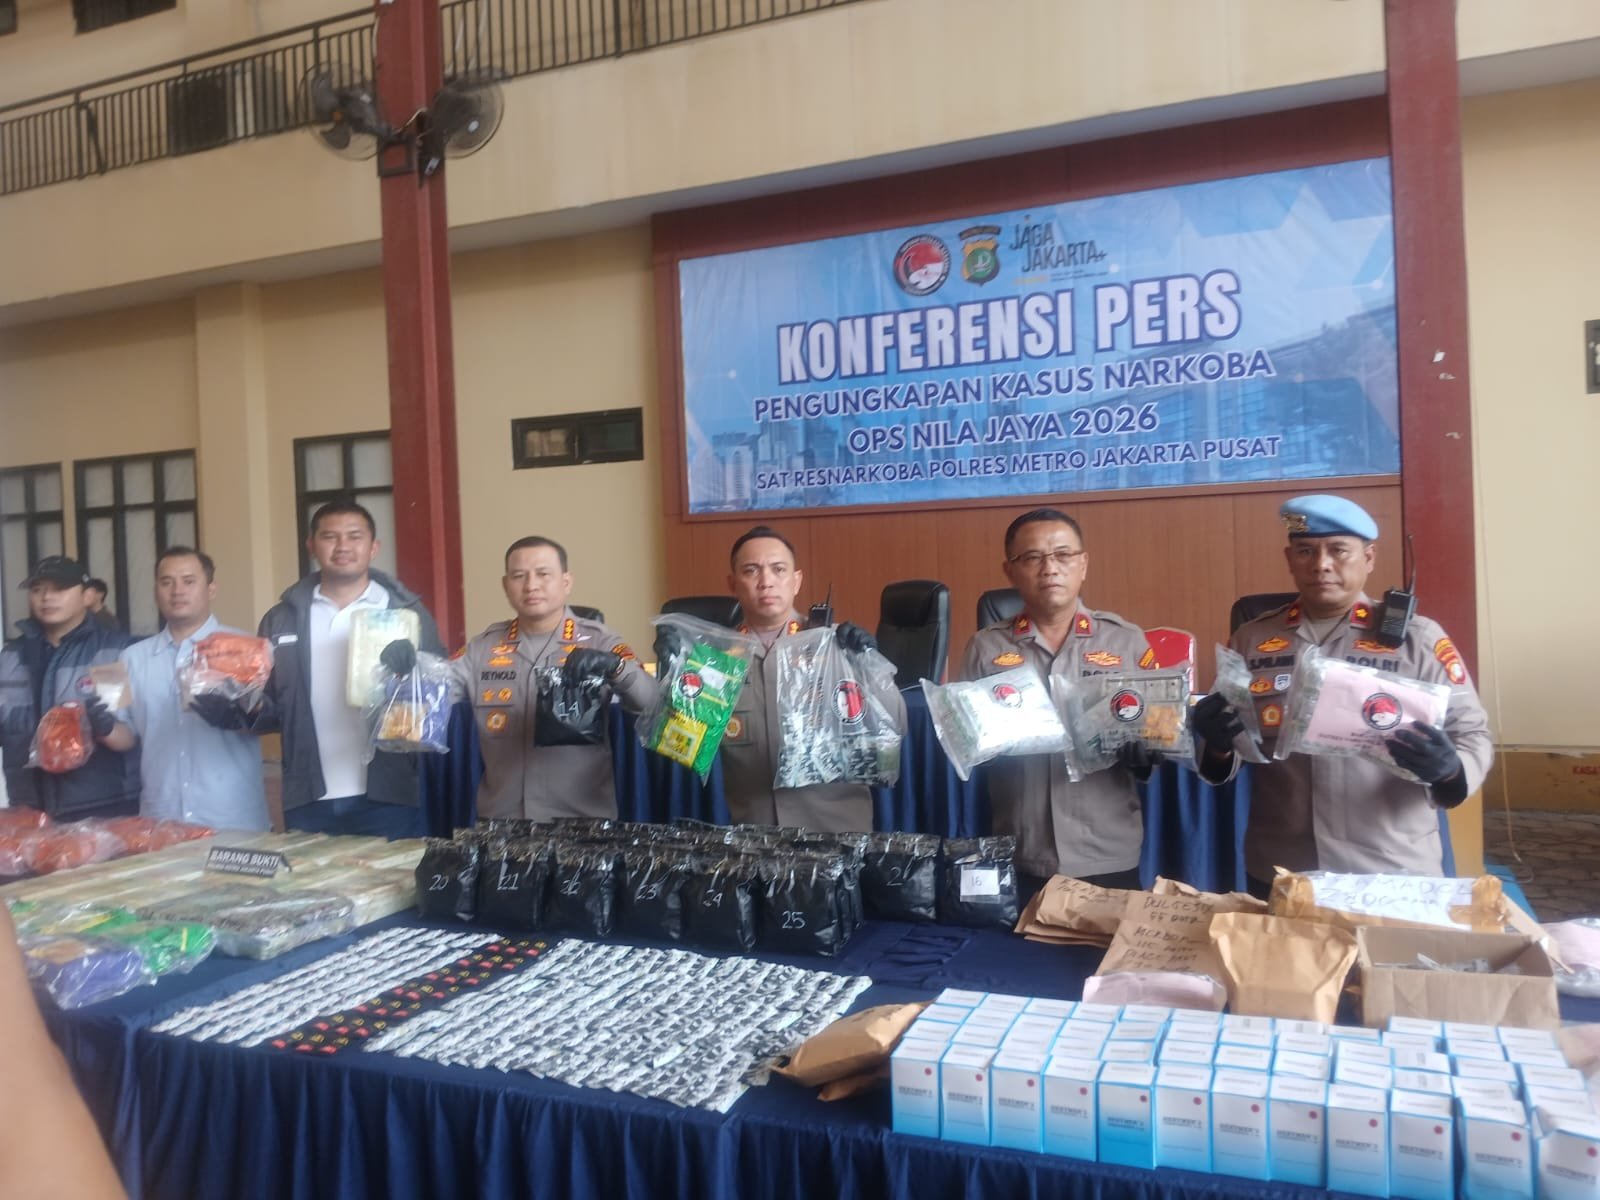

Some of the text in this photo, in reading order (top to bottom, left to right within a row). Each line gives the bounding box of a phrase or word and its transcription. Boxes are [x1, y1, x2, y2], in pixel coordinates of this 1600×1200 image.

[1009, 220, 1055, 250] JAGA
[777, 268, 1241, 386] KONFERENSI PERS
[755, 350, 1274, 421] PENGUNGKAPAN KASUS NARKOBA
[850, 403, 1158, 453] OPS NILA JAYA 2026
[757, 436, 1280, 489] SAT RESNARKOBA POLRES METRO JAKARTA PUSAT
[559, 701, 580, 717] 14
[210, 850, 279, 868] BARANG BUKTI
[428, 873, 449, 891] 20
[497, 872, 519, 890] 21
[781, 910, 806, 929] 25
